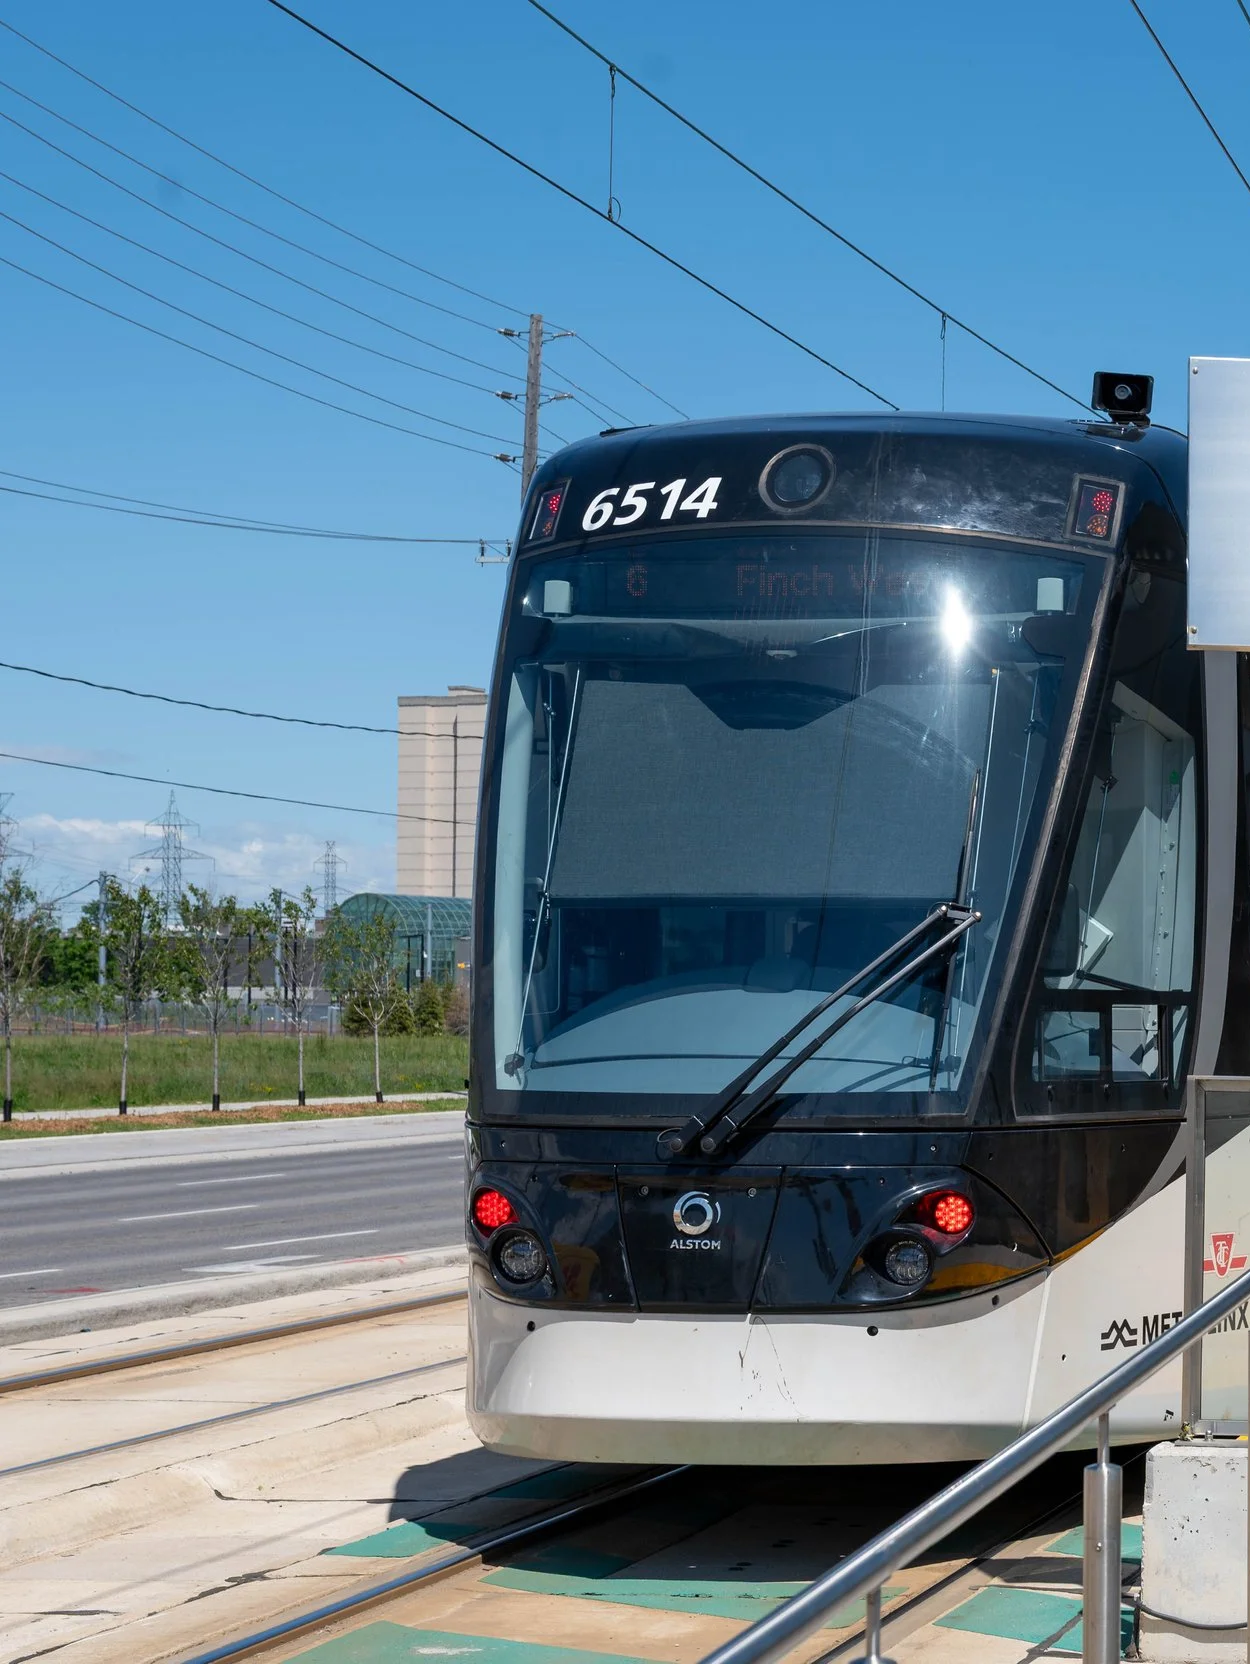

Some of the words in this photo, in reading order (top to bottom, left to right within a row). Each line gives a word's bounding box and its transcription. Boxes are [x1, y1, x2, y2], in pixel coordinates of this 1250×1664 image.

[582, 476, 723, 532] 6514
[735, 562, 834, 597] Finch
[670, 1239, 721, 1250] ALSTOM
